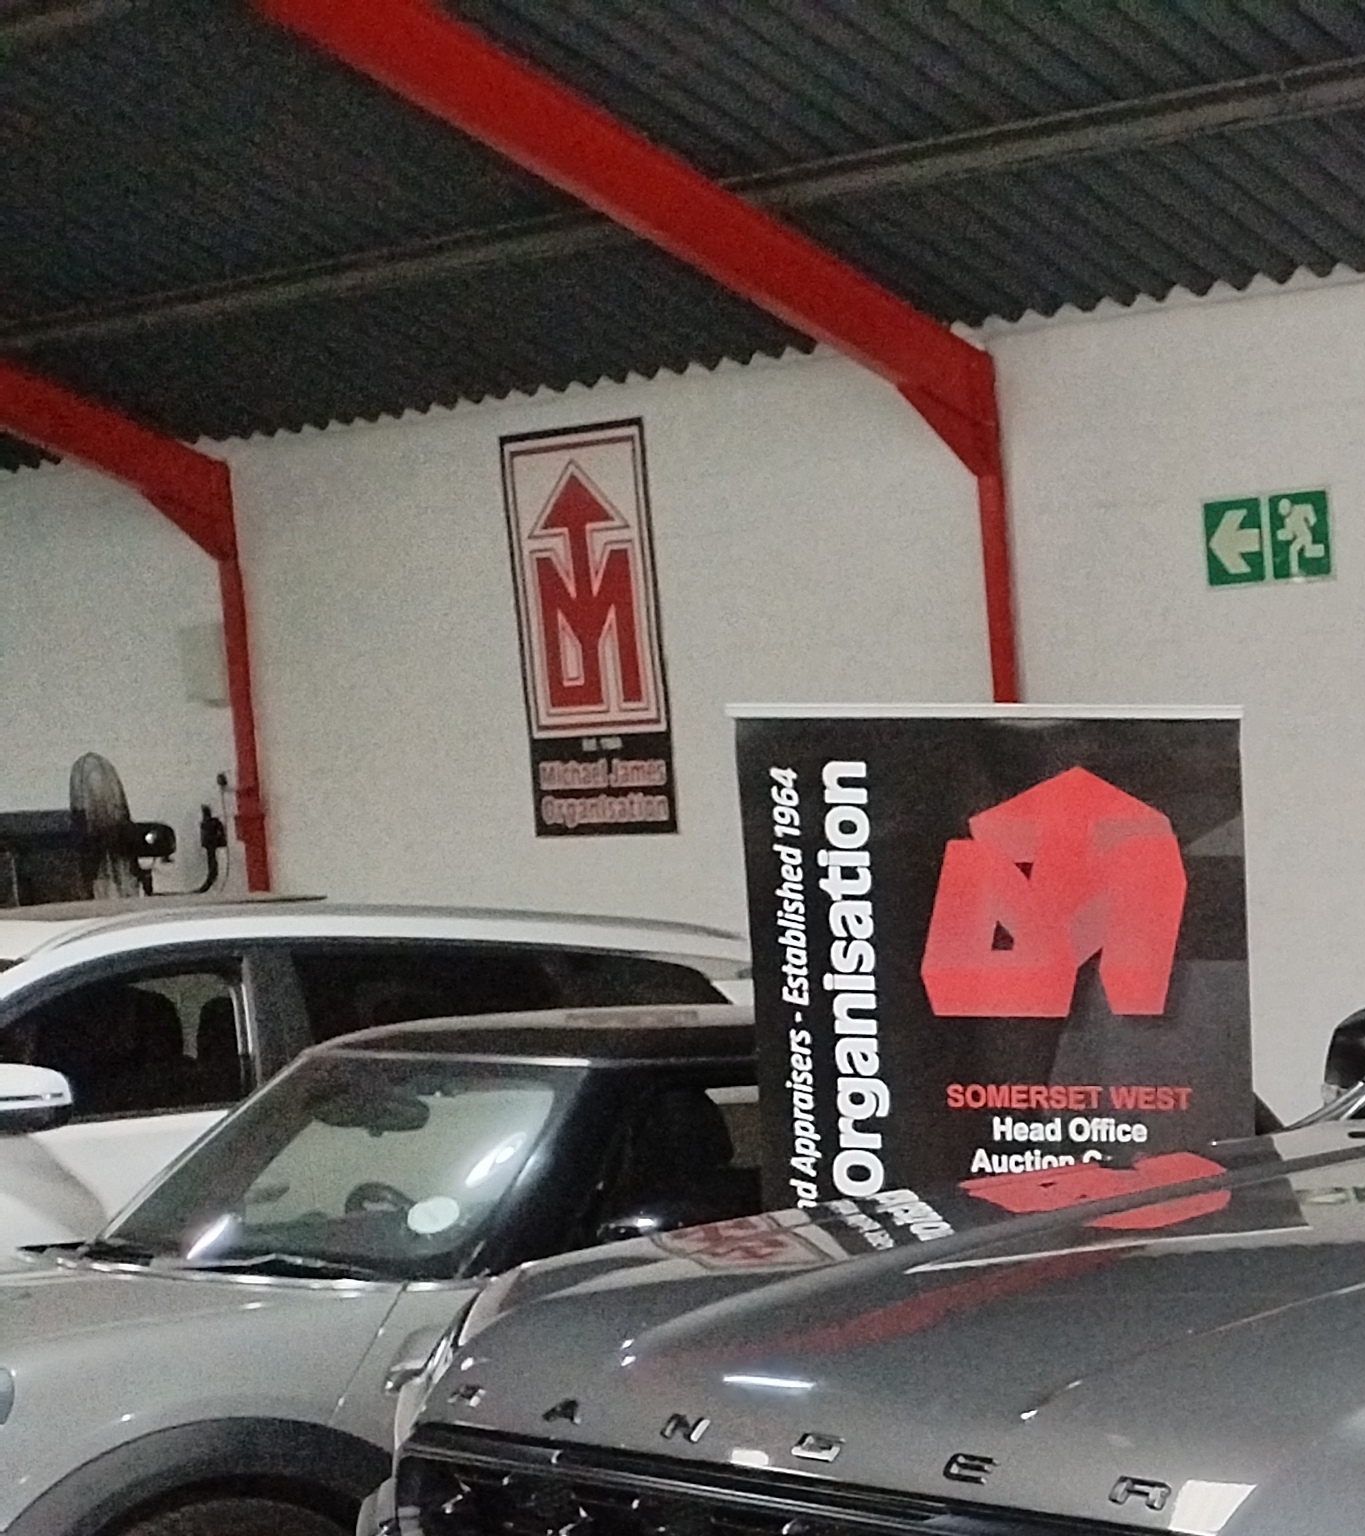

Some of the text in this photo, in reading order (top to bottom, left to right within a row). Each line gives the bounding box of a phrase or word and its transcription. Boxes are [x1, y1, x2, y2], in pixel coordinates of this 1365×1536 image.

[769, 766, 802, 838] 1964
[773, 844, 810, 1006] Established
[818, 760, 890, 1197] Organisation
[789, 1028, 822, 1177] Appraisers
[946, 1083, 1193, 1111] SOMERSET WEST
[993, 1116, 1148, 1143] Head Office
